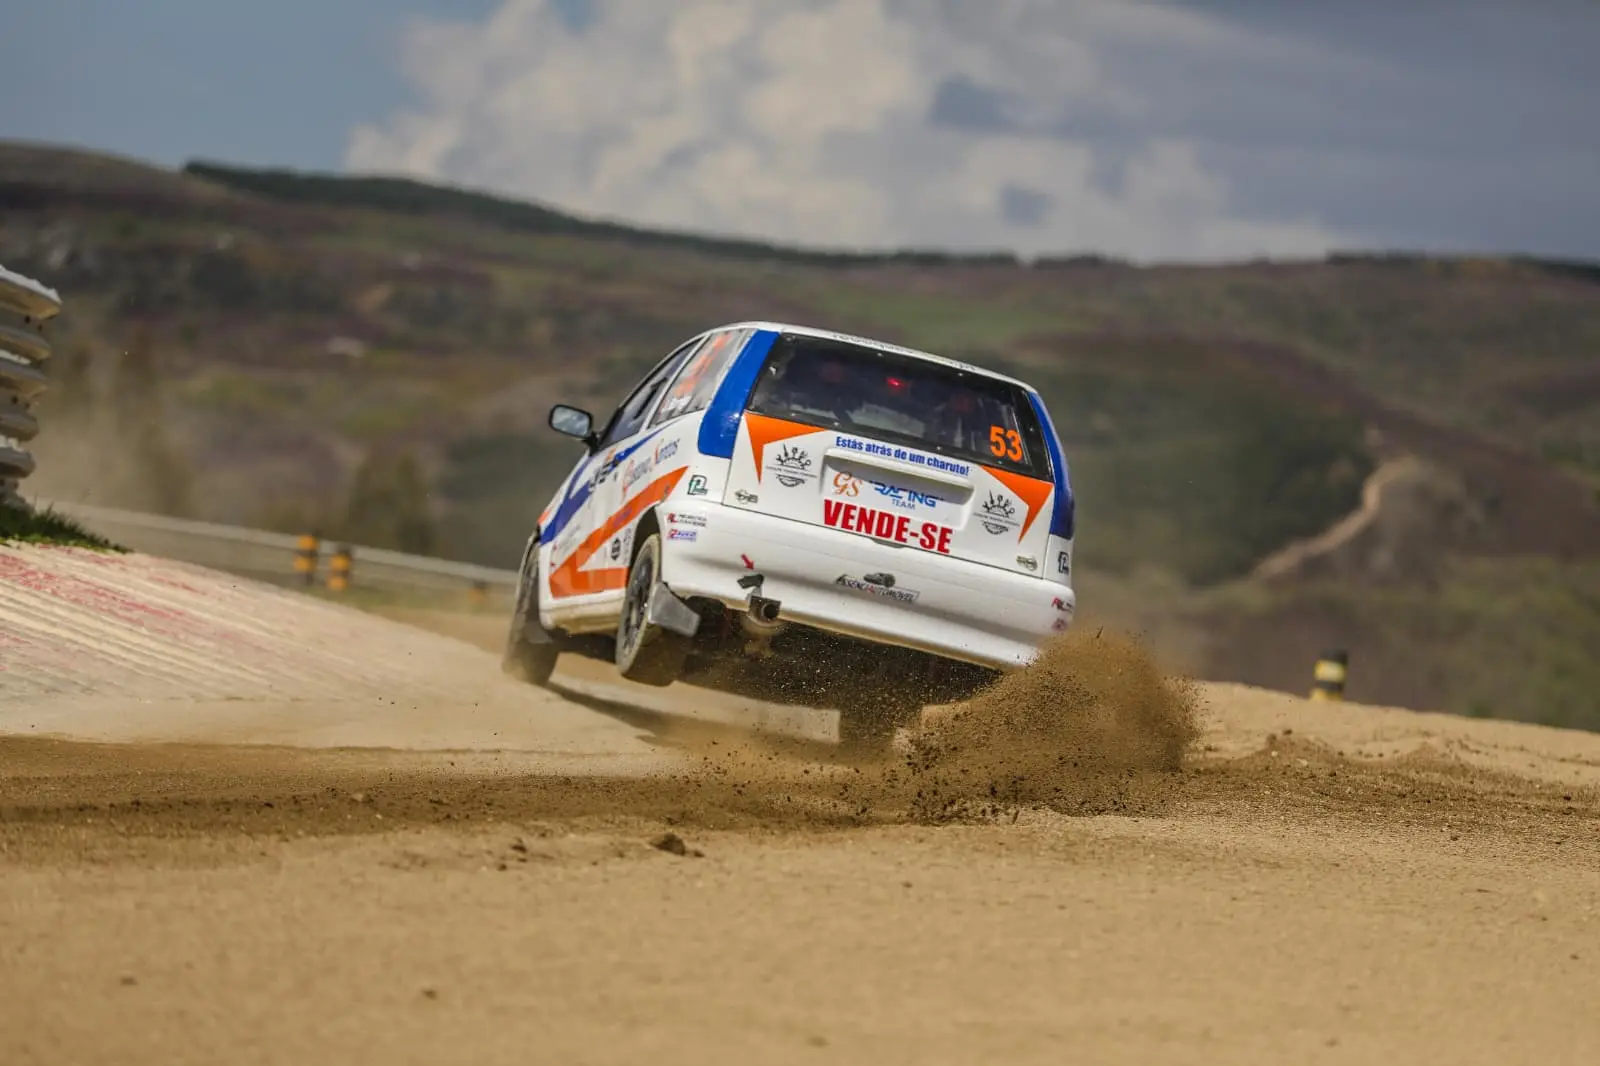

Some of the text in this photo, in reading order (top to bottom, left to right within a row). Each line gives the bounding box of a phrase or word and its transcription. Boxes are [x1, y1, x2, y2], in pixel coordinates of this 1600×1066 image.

[836, 435, 969, 476] Estás atrás de um charuto!
[990, 424, 1023, 462] 53
[891, 499, 916, 510] TEAM
[824, 499, 953, 554] VENDE-SE
